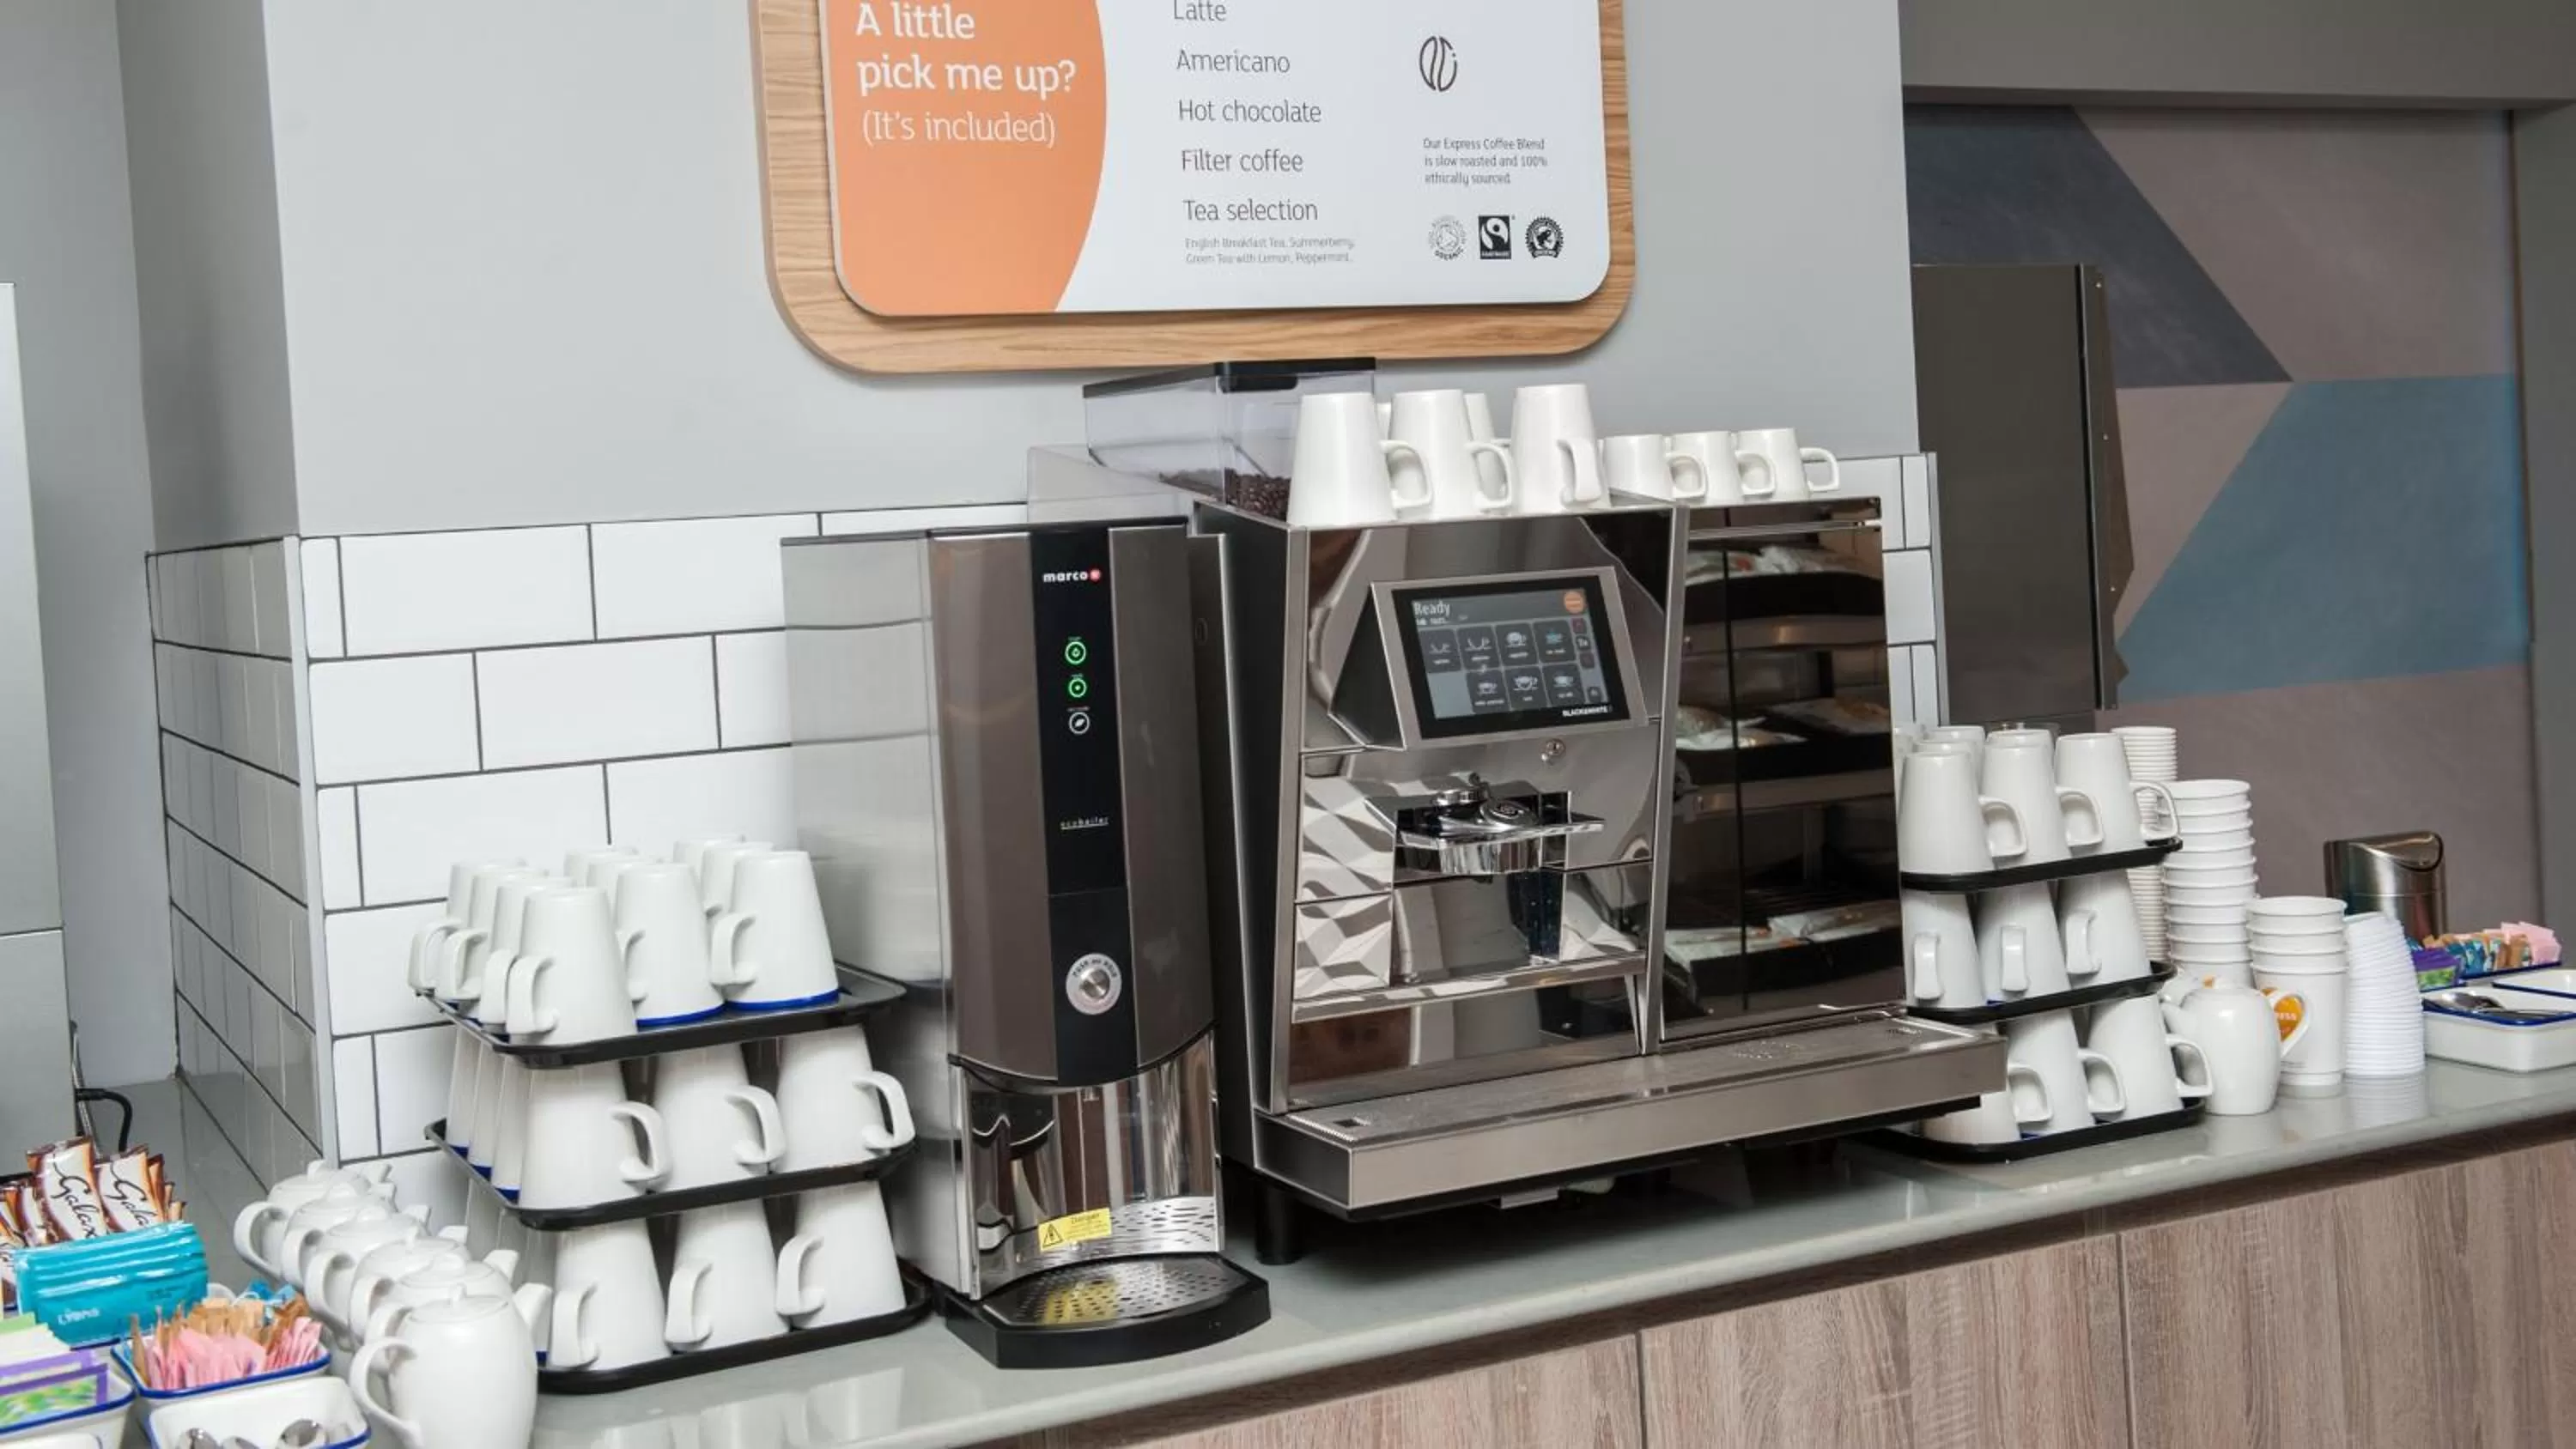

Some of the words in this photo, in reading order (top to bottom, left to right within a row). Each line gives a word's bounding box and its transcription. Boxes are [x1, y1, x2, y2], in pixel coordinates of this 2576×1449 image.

[856, 3, 882, 37] A
[890, 1, 975, 39] little
[1174, 0, 1227, 21] Latte
[1176, 49, 1291, 73] Americano
[857, 53, 935, 97] pick
[945, 63, 1003, 90] me
[1015, 59, 1076, 100] up?
[1179, 100, 1214, 122] Hot
[1222, 99, 1322, 124] chocolate
[863, 109, 916, 146] (It's
[925, 111, 1055, 149] included)
[1423, 137, 1441, 149] Our
[1443, 137, 1481, 151] Express
[1483, 137, 1516, 149] Coffee
[1516, 138, 1545, 150] Blend
[1182, 148, 1231, 172] Filter
[1239, 149, 1304, 173] coffee
[1425, 155, 1433, 167] is
[1435, 155, 1457, 167] slow
[1459, 155, 1497, 167] roasted
[1498, 156, 1518, 167] and
[1521, 155, 1548, 167] 100%
[1425, 172, 1469, 186] ethically
[1182, 199, 1220, 221] Tea
[1226, 198, 1319, 221] selection
[1042, 571, 1088, 583] marco
[1413, 600, 1450, 615] Ready
